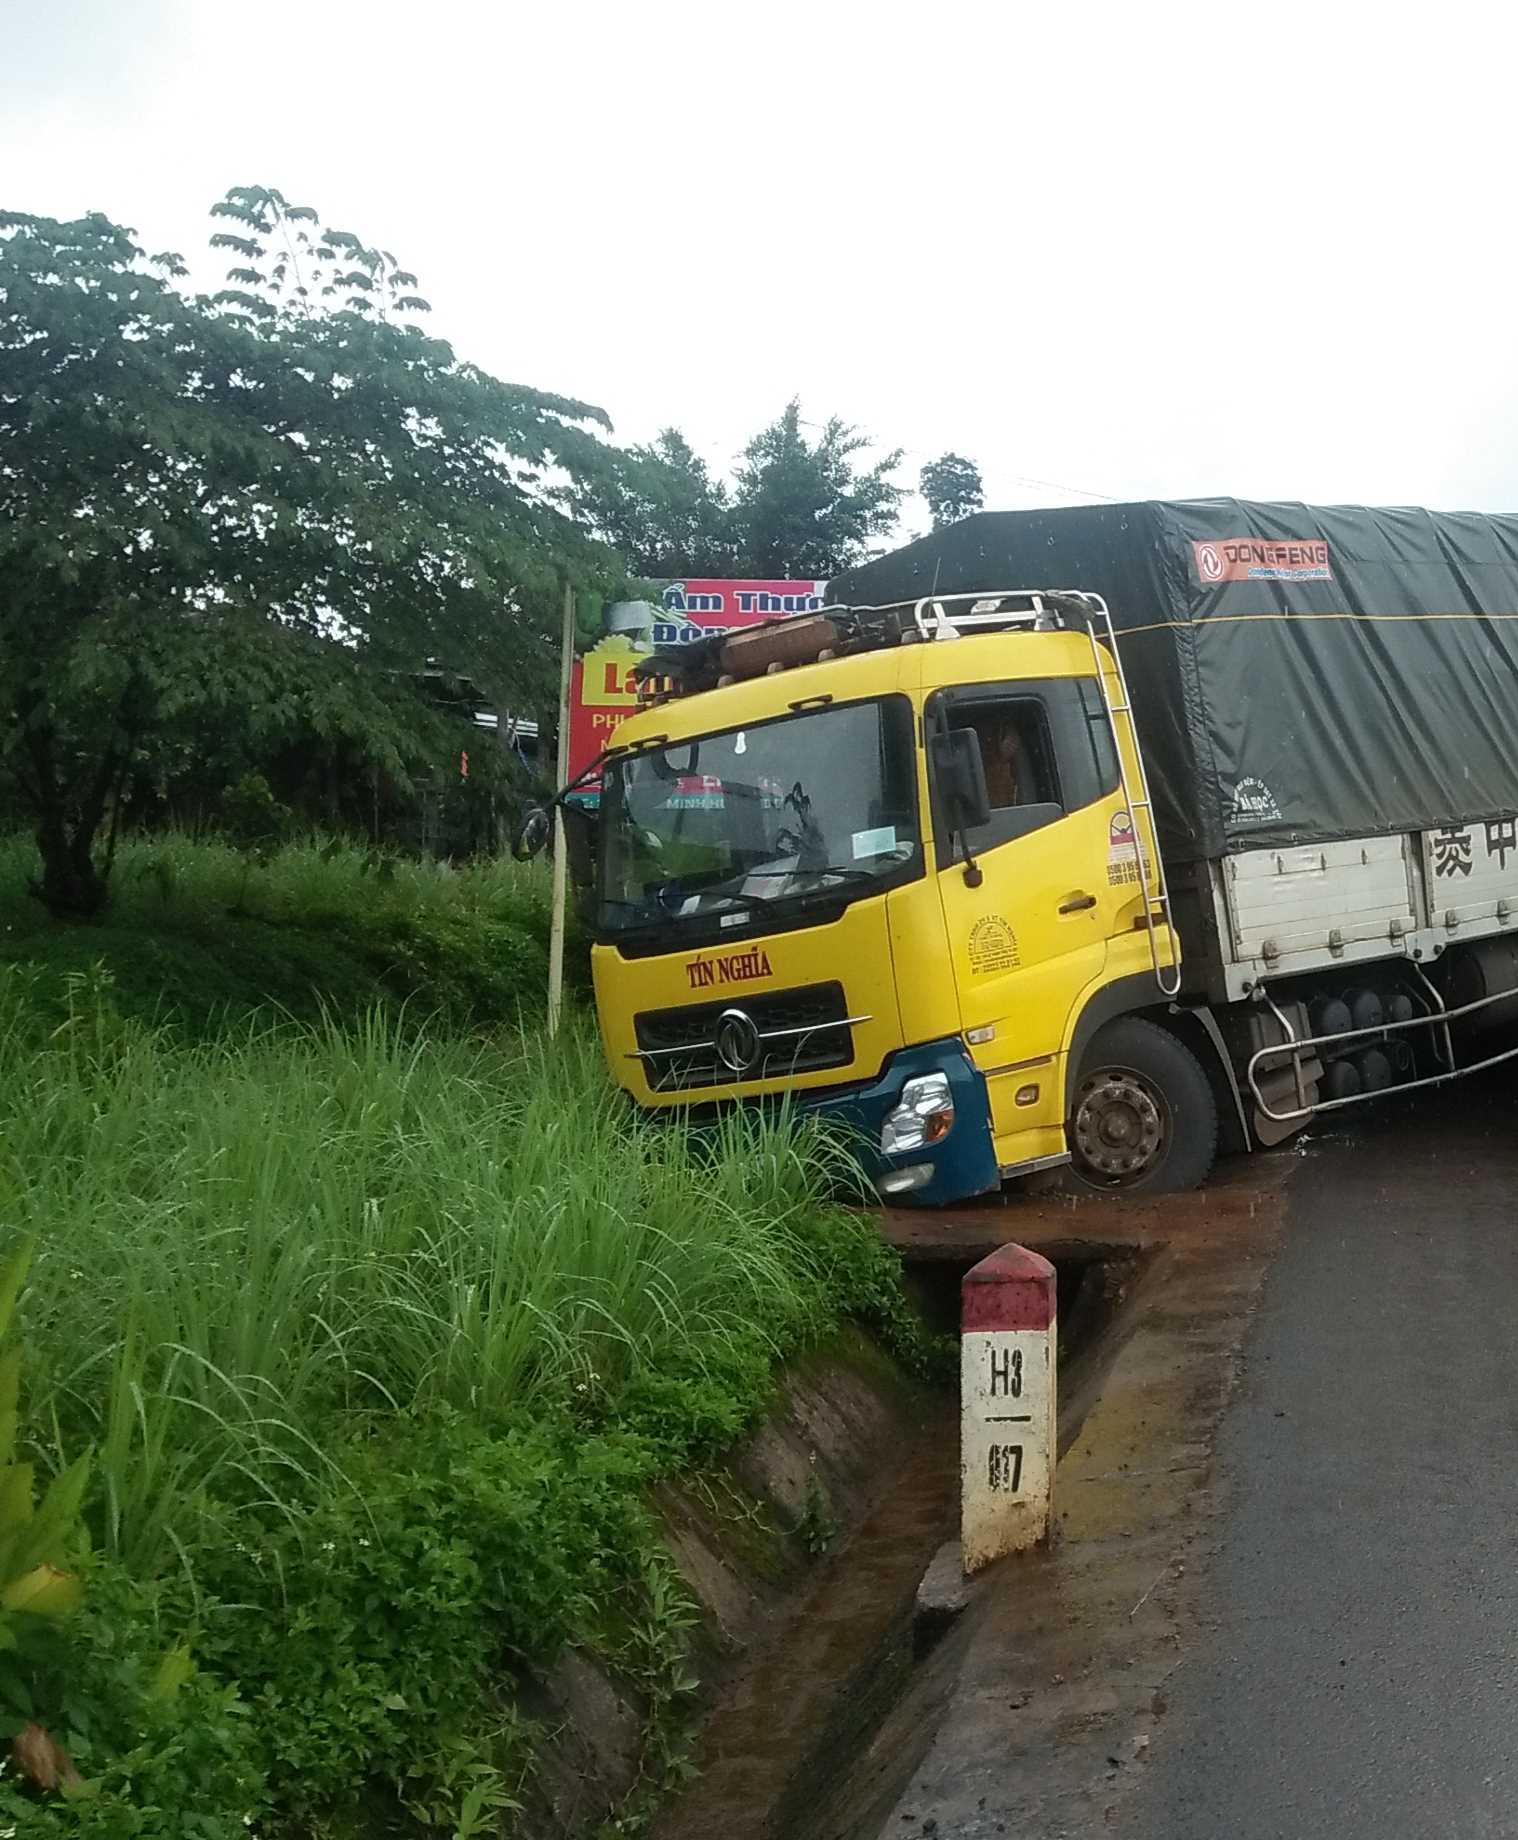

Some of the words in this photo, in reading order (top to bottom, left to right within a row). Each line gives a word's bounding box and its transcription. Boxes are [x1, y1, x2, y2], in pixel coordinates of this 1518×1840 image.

[1223, 545, 1329, 564] DONGFENG
[687, 954, 714, 988] TÍN
[718, 945, 773, 983] NGHĨA
[990, 1348, 1023, 1398] H3
